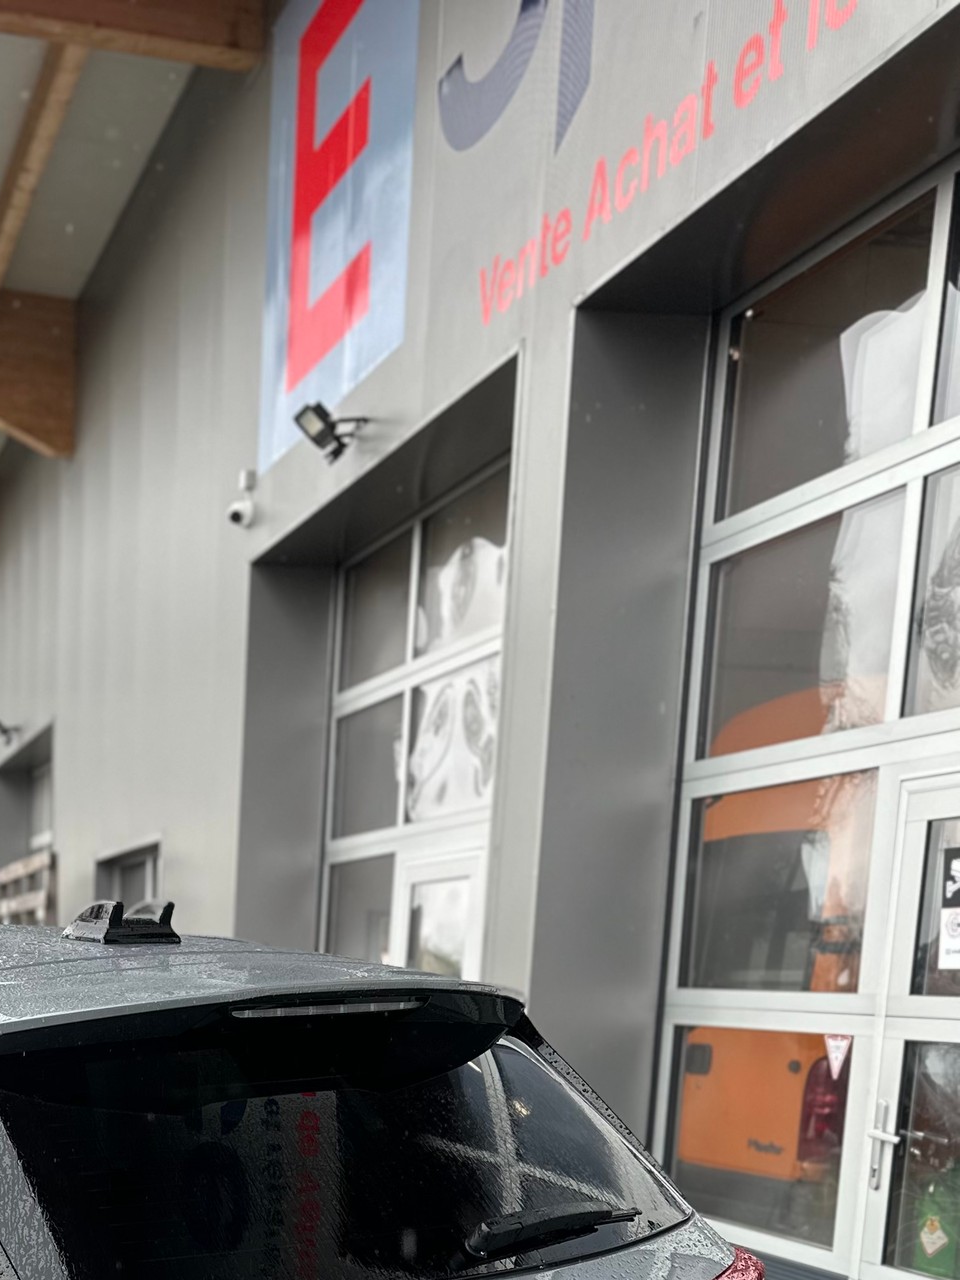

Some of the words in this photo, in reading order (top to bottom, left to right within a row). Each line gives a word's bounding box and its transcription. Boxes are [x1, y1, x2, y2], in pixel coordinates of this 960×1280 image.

[479, 207, 572, 326] Vente
[582, 60, 718, 243] Achat
[733, 0, 788, 109] et
